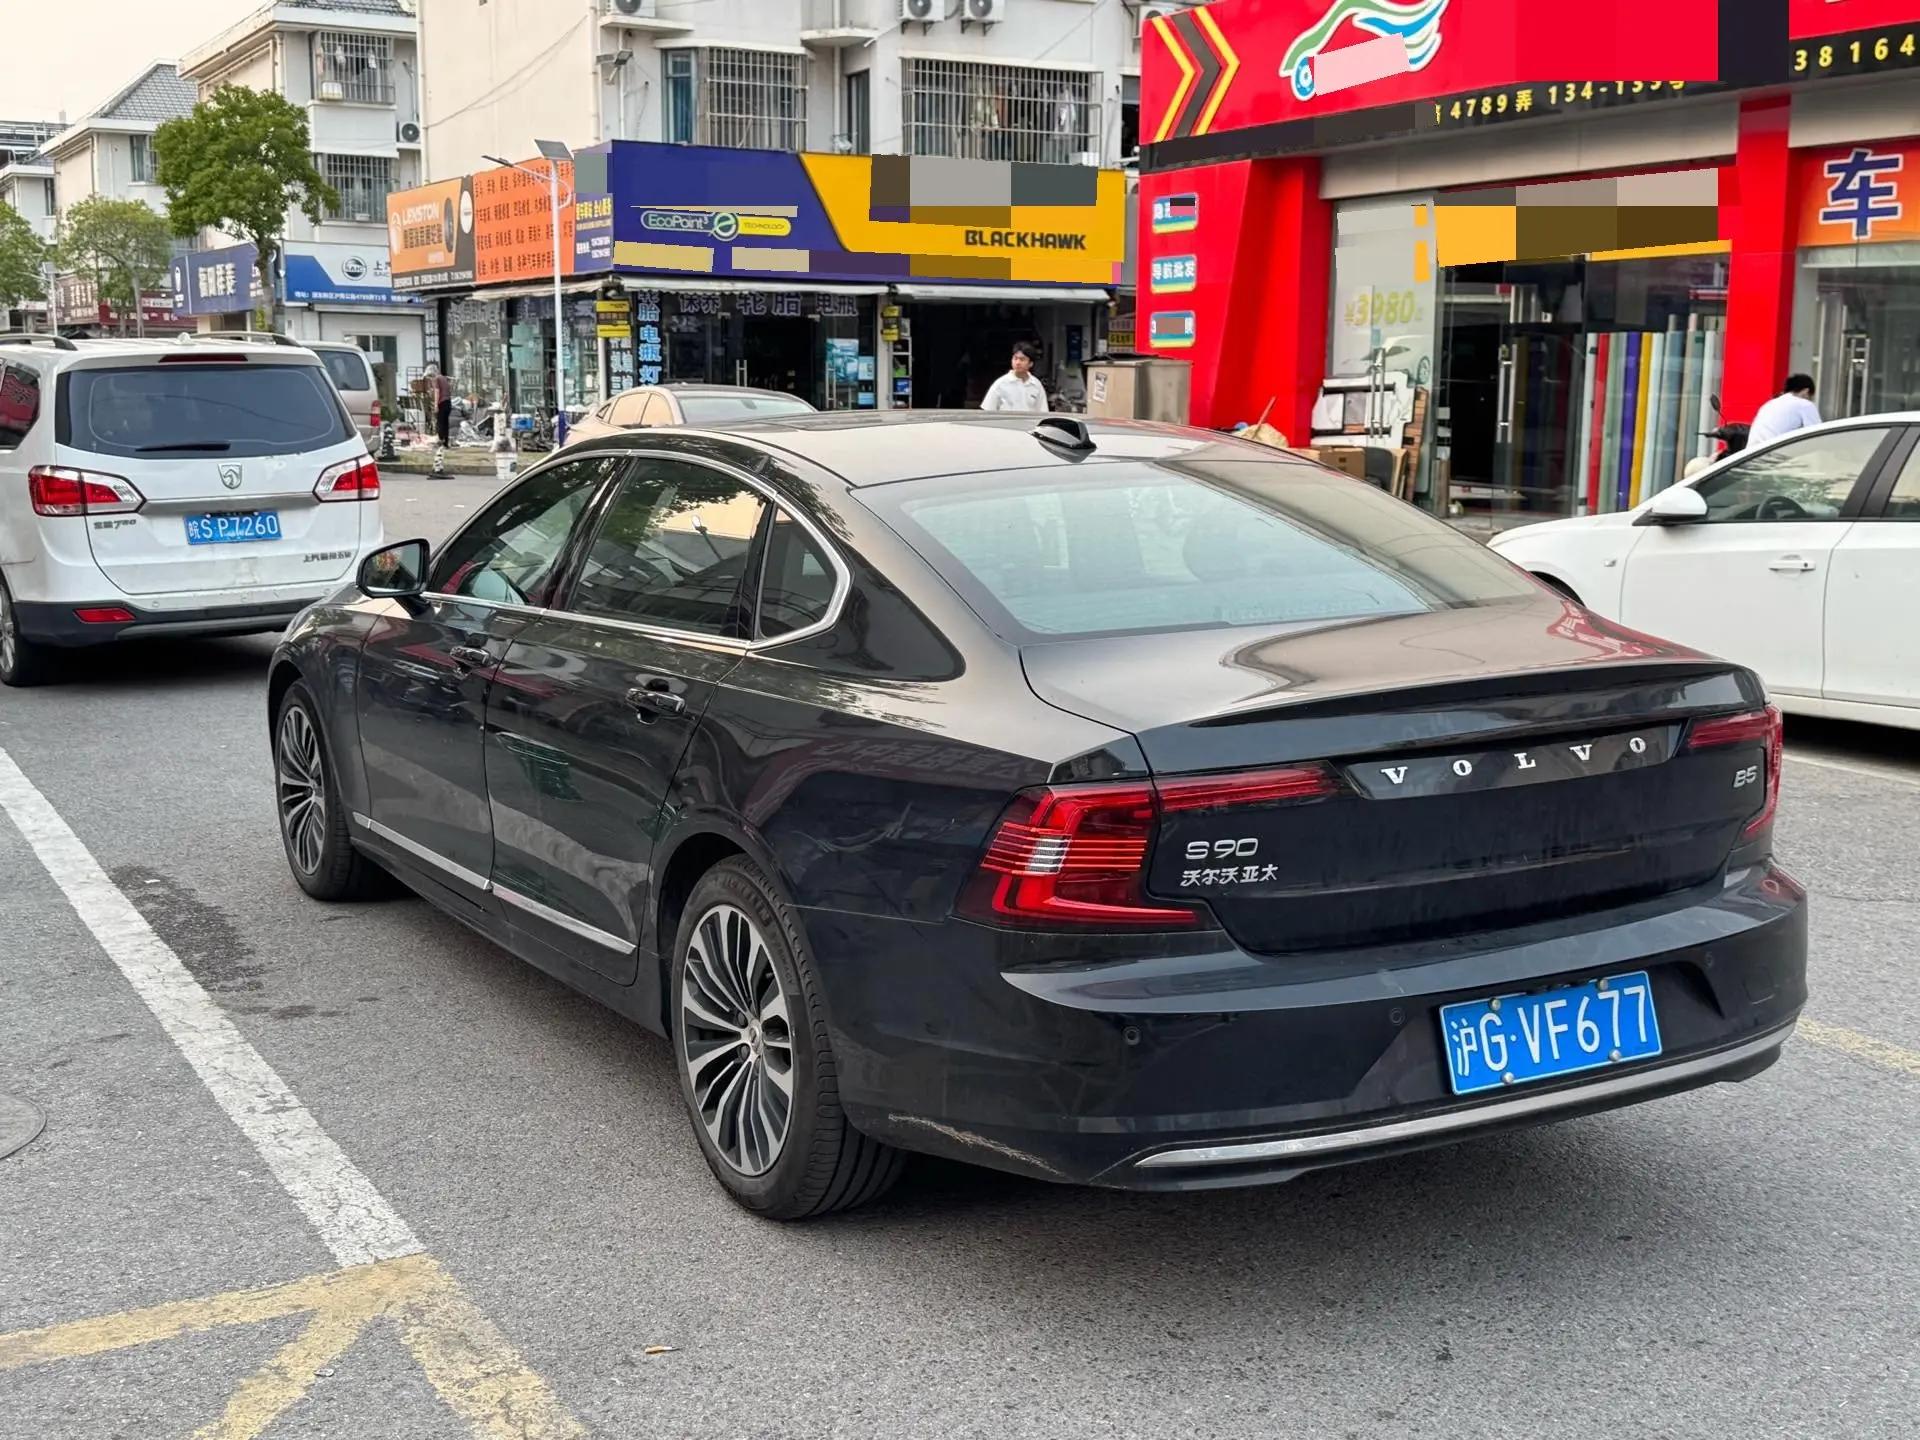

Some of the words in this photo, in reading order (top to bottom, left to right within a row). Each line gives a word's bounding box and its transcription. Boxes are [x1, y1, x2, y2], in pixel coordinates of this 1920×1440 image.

[1819, 147, 1904, 241] 车
[965, 229, 1087, 251] BLACKHAWK
[1380, 736, 1647, 786] VOLVO
[1733, 765, 1758, 789] B5
[1184, 838, 1259, 861] S90
[1180, 863, 1279, 887] 沃尔沃亚太
